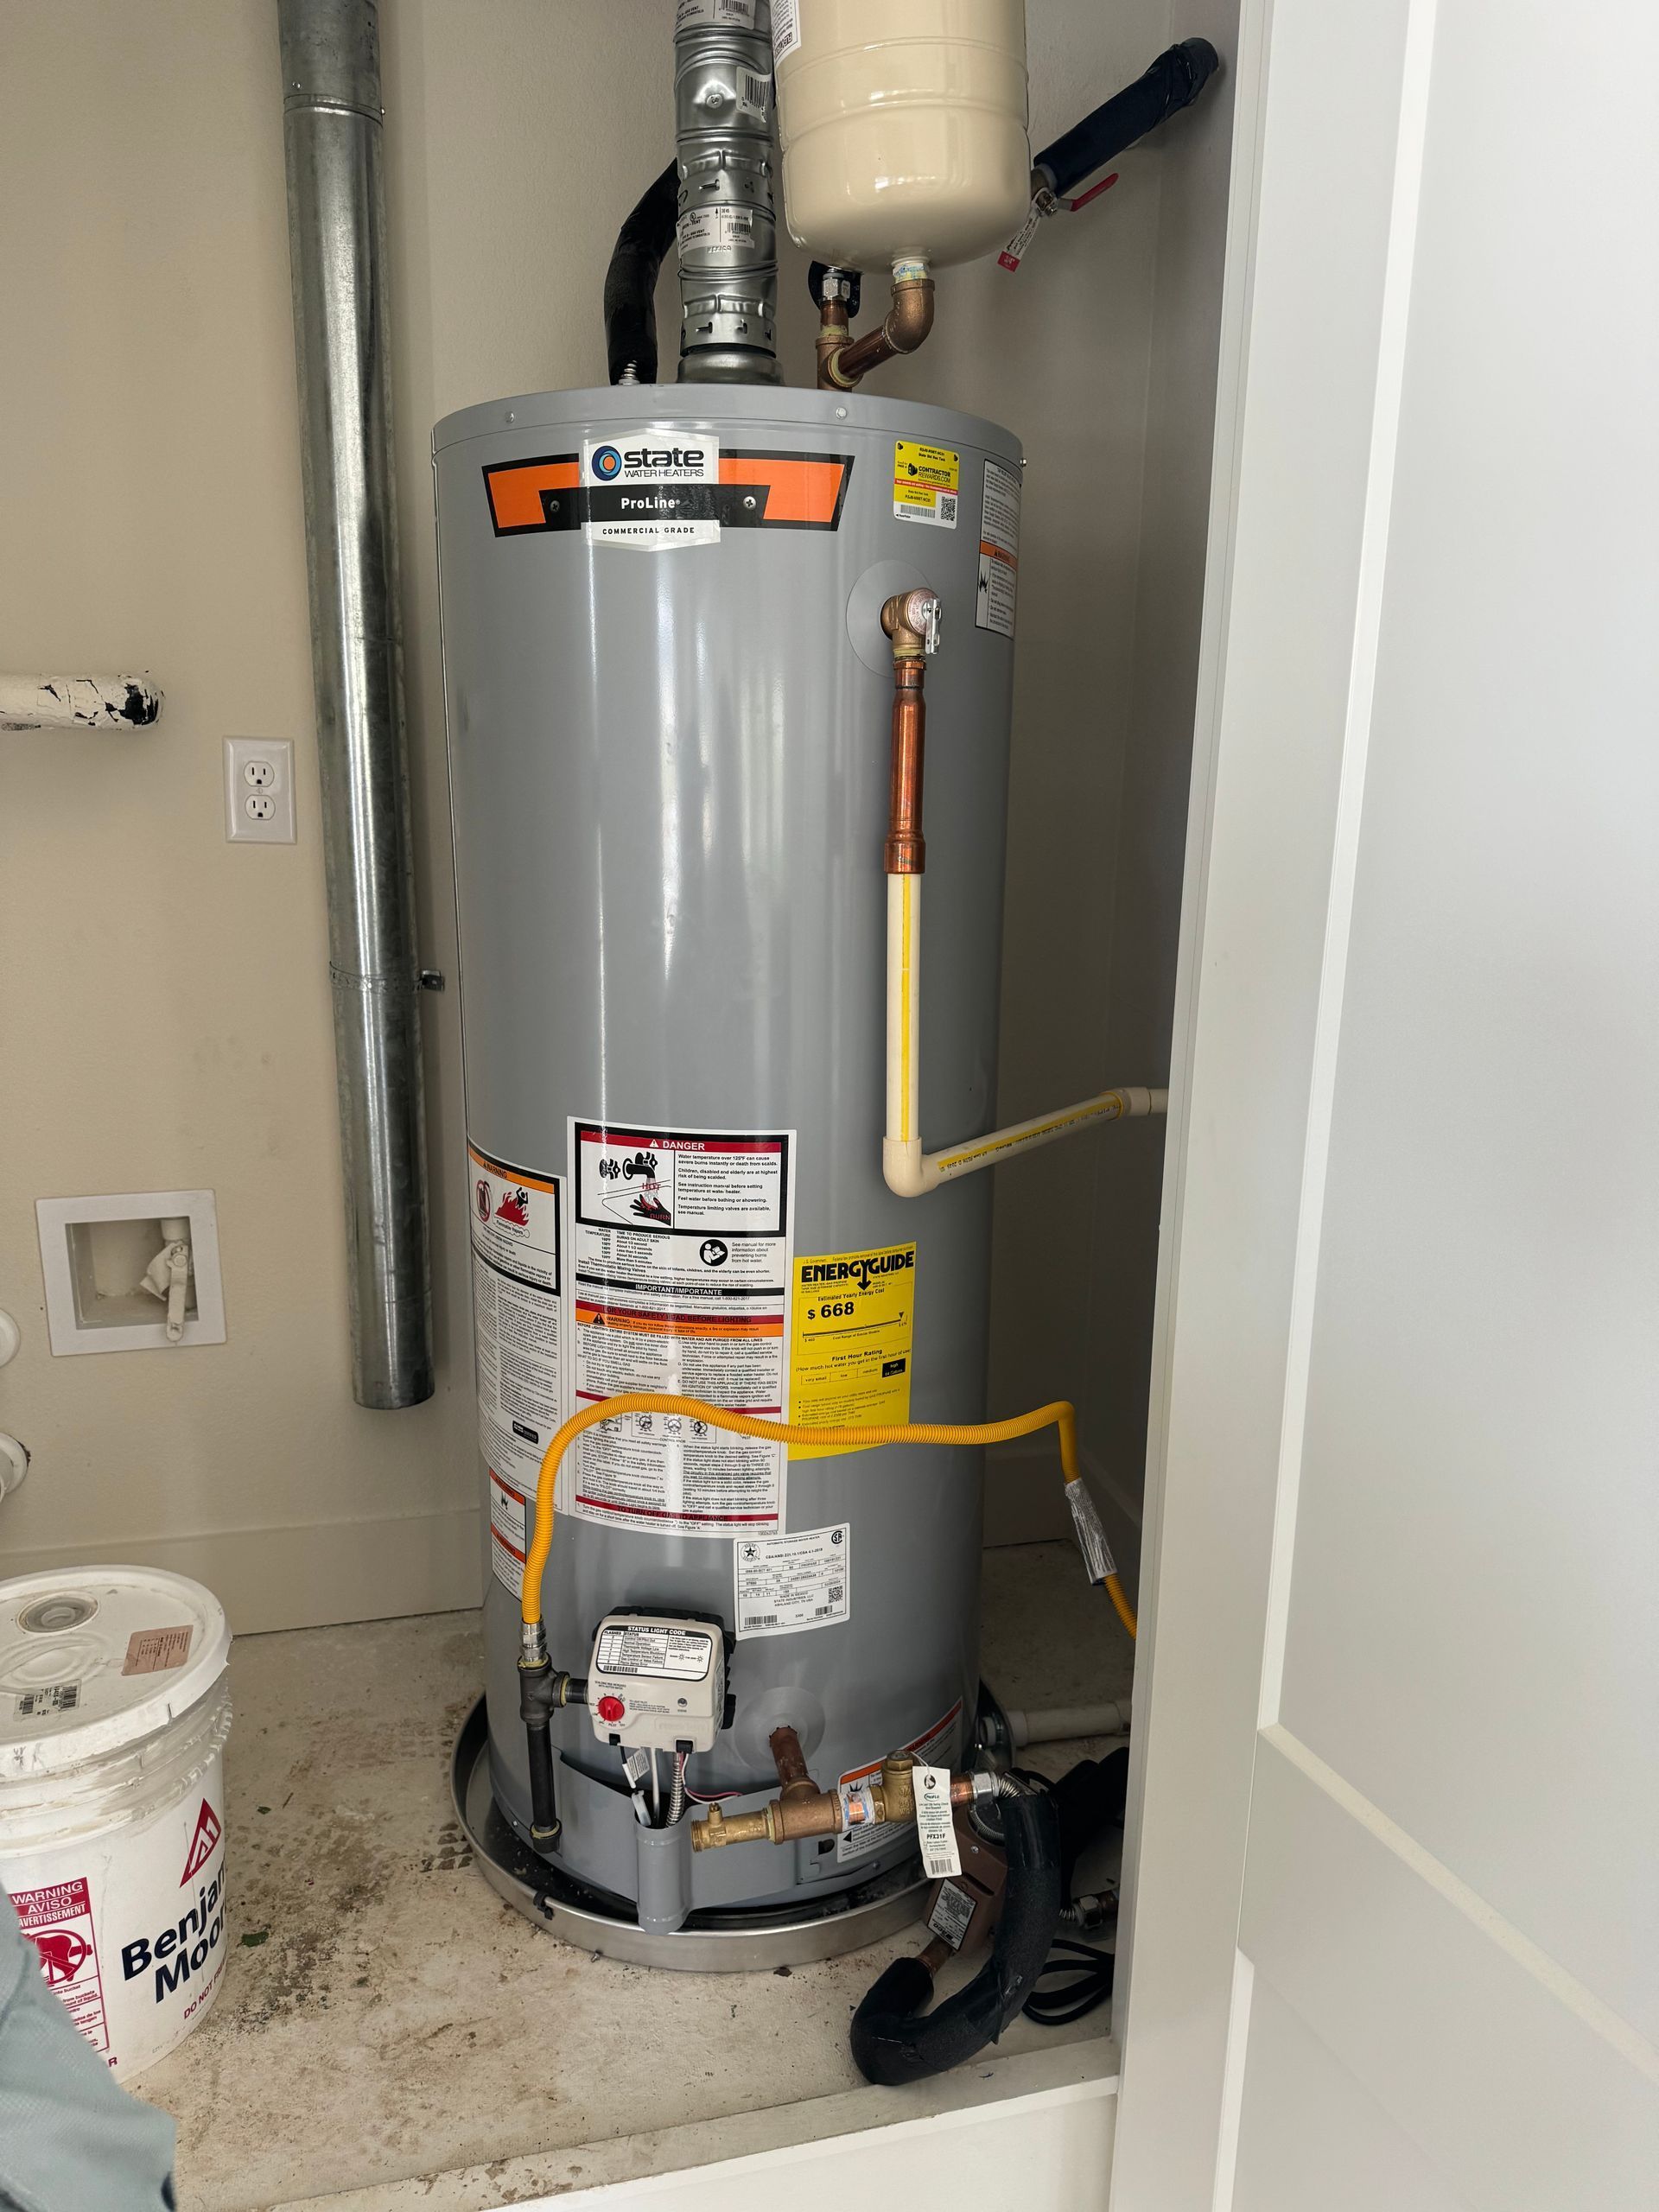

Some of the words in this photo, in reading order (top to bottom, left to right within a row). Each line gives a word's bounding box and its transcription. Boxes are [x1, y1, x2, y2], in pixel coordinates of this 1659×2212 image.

[624, 448, 704, 468] state
[918, 466, 950, 477] CONTRACTOR
[918, 472, 950, 483] REWARDS.COM
[663, 1141, 705, 1151] DANGER
[487, 1165, 507, 1179] WARNING
[801, 1250, 914, 1283] ENERGYGUIDE
[635, 1283, 722, 1296] IMPORTANT/IMPORTANTE
[603, 1305, 617, 1313] OR
[618, 1307, 638, 1316] YOUR
[639, 1311, 666, 1320] SAFETY
[807, 1309, 816, 1320] $
[821, 1301, 855, 1319] 668
[12, 1881, 83, 1904] WARNING
[19, 1903, 86, 1927] AVERTISSEMENT
[28, 1897, 72, 1915] AVISO
[183, 2001, 197, 2019] DO
[199, 1979, 213, 2004] NOT
